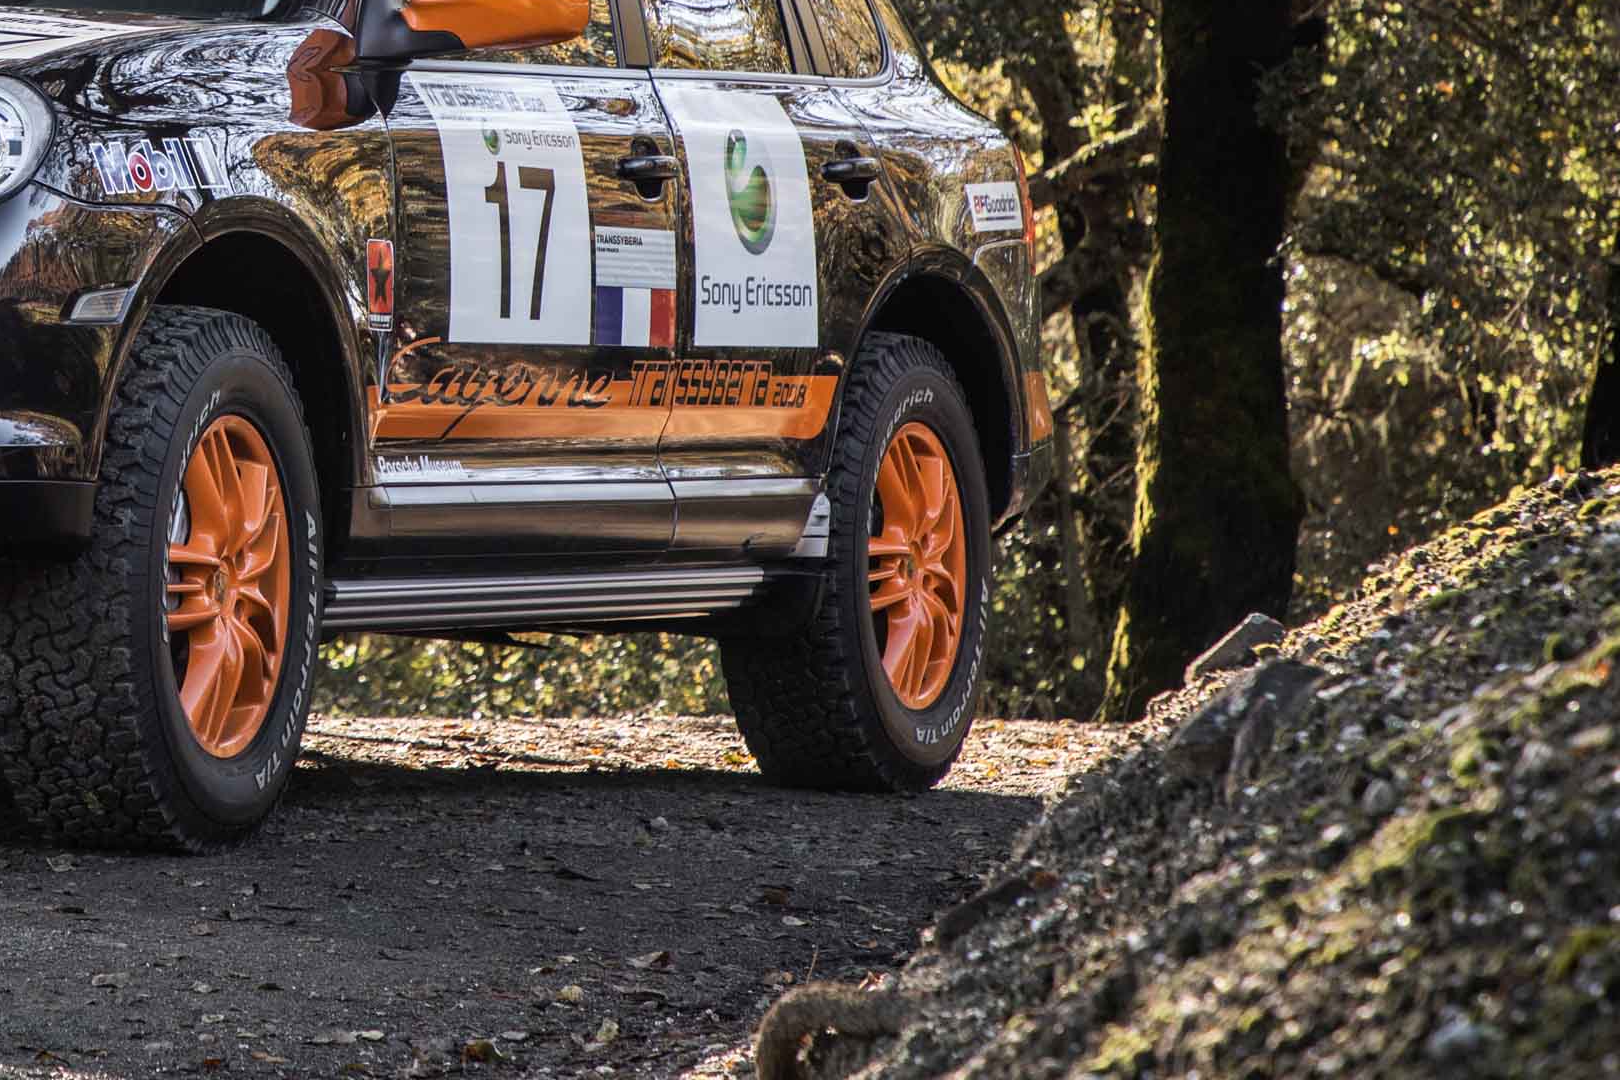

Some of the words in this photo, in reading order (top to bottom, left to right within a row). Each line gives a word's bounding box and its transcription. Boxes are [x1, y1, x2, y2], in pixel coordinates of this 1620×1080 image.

[504, 128, 532, 150] Sony
[533, 130, 575, 148] Ericsson
[89, 138, 197, 194] Mobil
[485, 161, 555, 320] 17
[596, 234, 643, 246] TRANSSYBERIA
[701, 275, 741, 313] Sony
[745, 276, 812, 306] Ericsson
[378, 455, 420, 473] Porsche
[281, 511, 318, 747] All-Terrain
